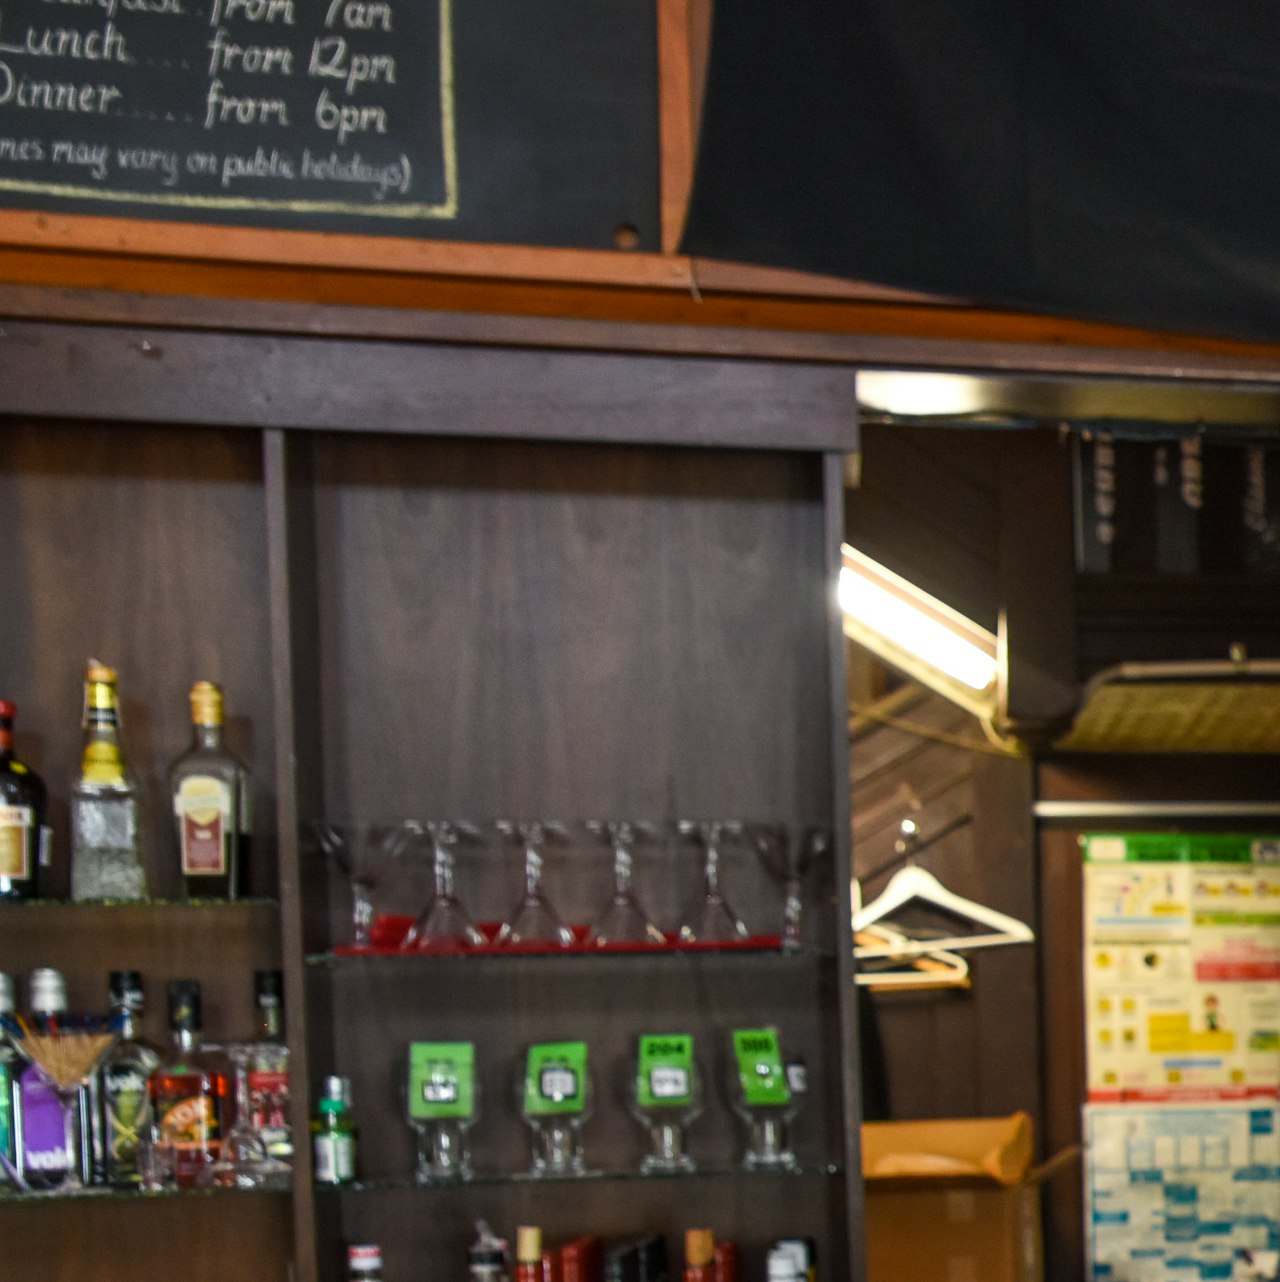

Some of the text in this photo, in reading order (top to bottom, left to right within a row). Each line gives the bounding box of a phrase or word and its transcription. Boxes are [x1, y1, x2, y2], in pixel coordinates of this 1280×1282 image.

[0, 21, 397, 96] unch from 12pm
[204, 79, 289, 129] from
[315, 87, 387, 145] 6pm
[52, 140, 109, 179] may
[117, 149, 179, 186] vary
[186, 152, 218, 173] on
[223, 146, 294, 188] public
